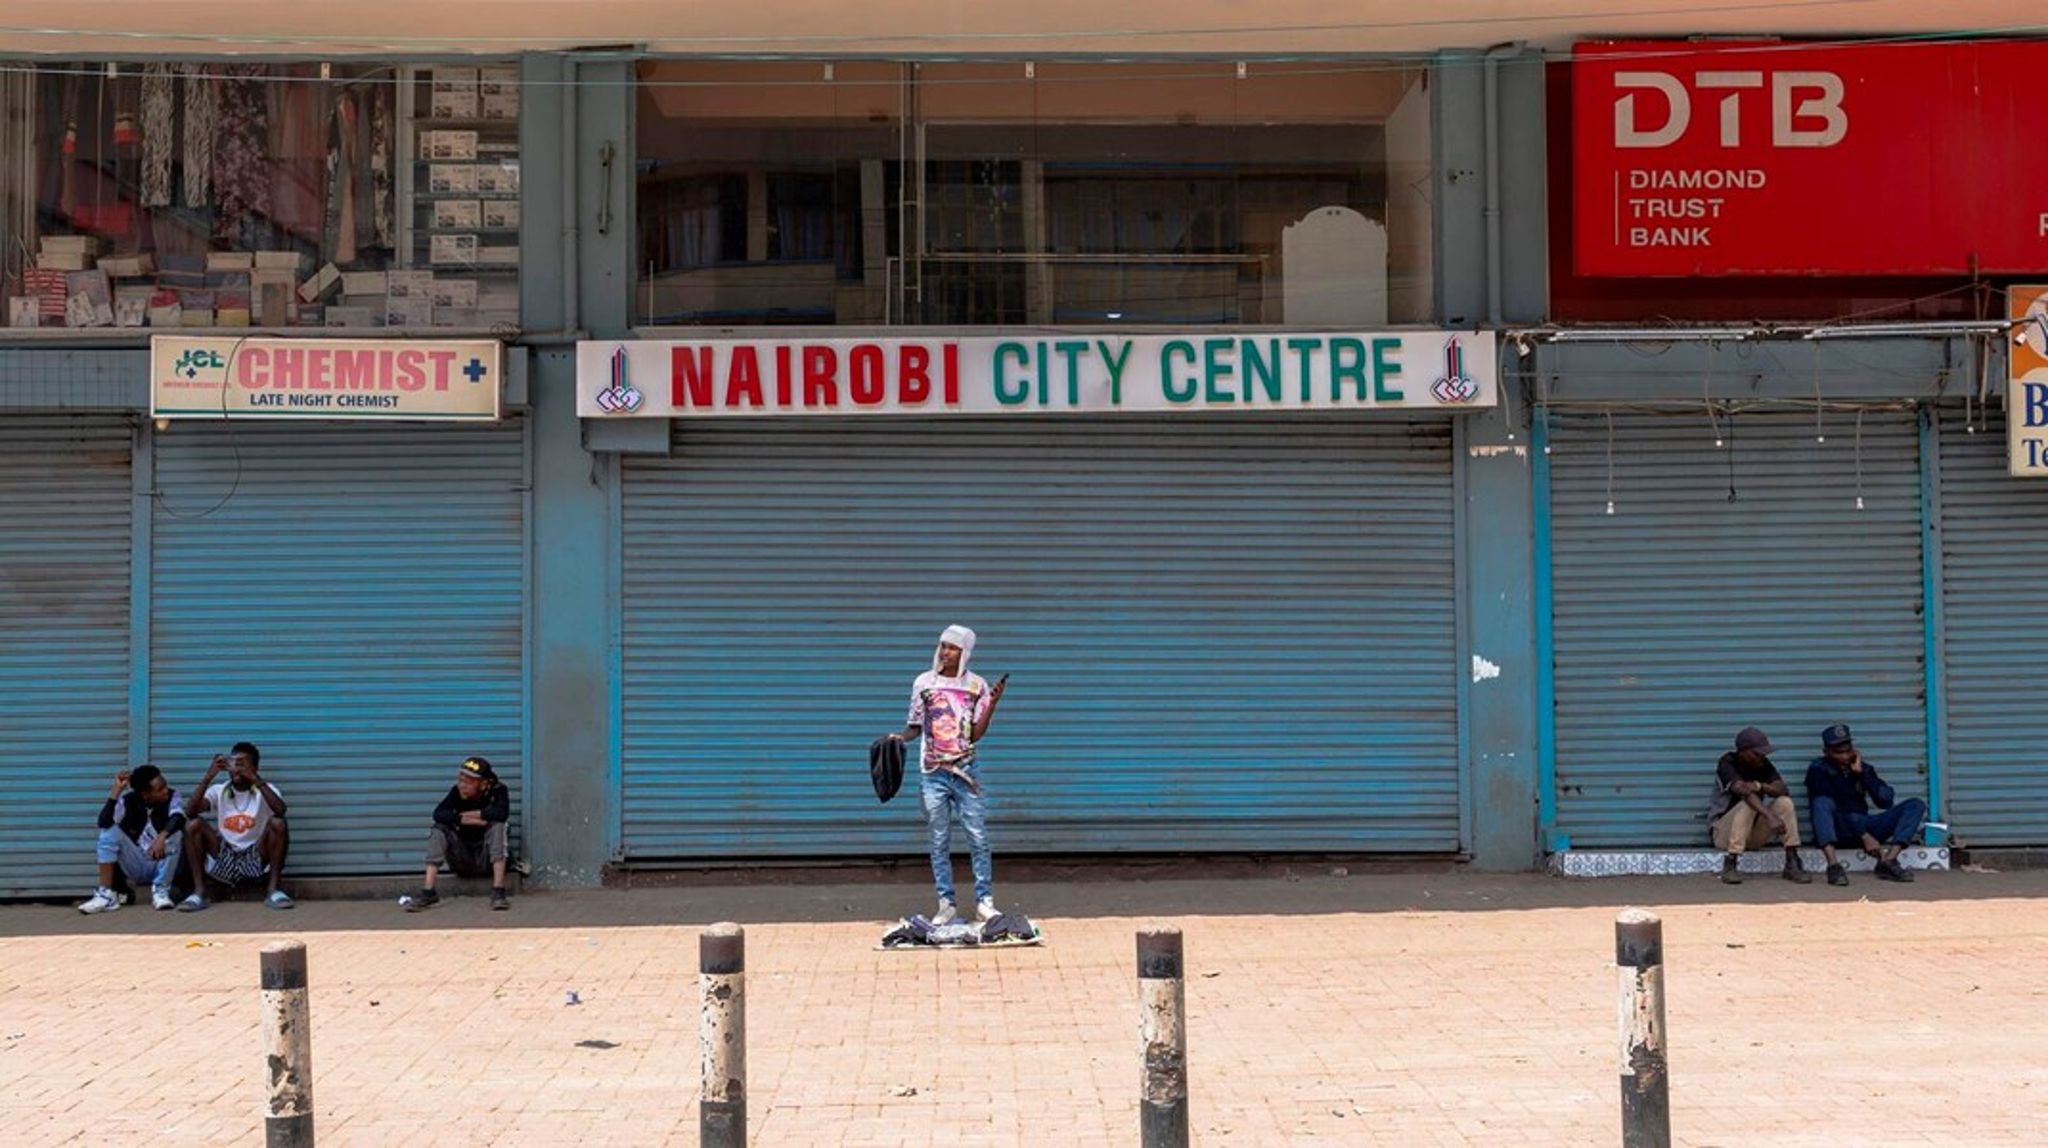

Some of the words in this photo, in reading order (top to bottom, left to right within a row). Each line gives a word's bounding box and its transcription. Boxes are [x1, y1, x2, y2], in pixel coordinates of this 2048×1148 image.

[1615, 71, 1848, 148] DTB
[1630, 170, 1766, 189] DIAMOND
[1629, 199, 1725, 218] TRUST
[1630, 227, 1711, 246] BANK
[238, 347, 457, 392] CHEMIST
[671, 343, 959, 407] NAIROBI
[993, 340, 1133, 406] CITY
[1160, 338, 1404, 404] CENTRE
[250, 393, 284, 406] LATE
[289, 394, 333, 407] NIGHT
[337, 394, 399, 408] CHEMIST
